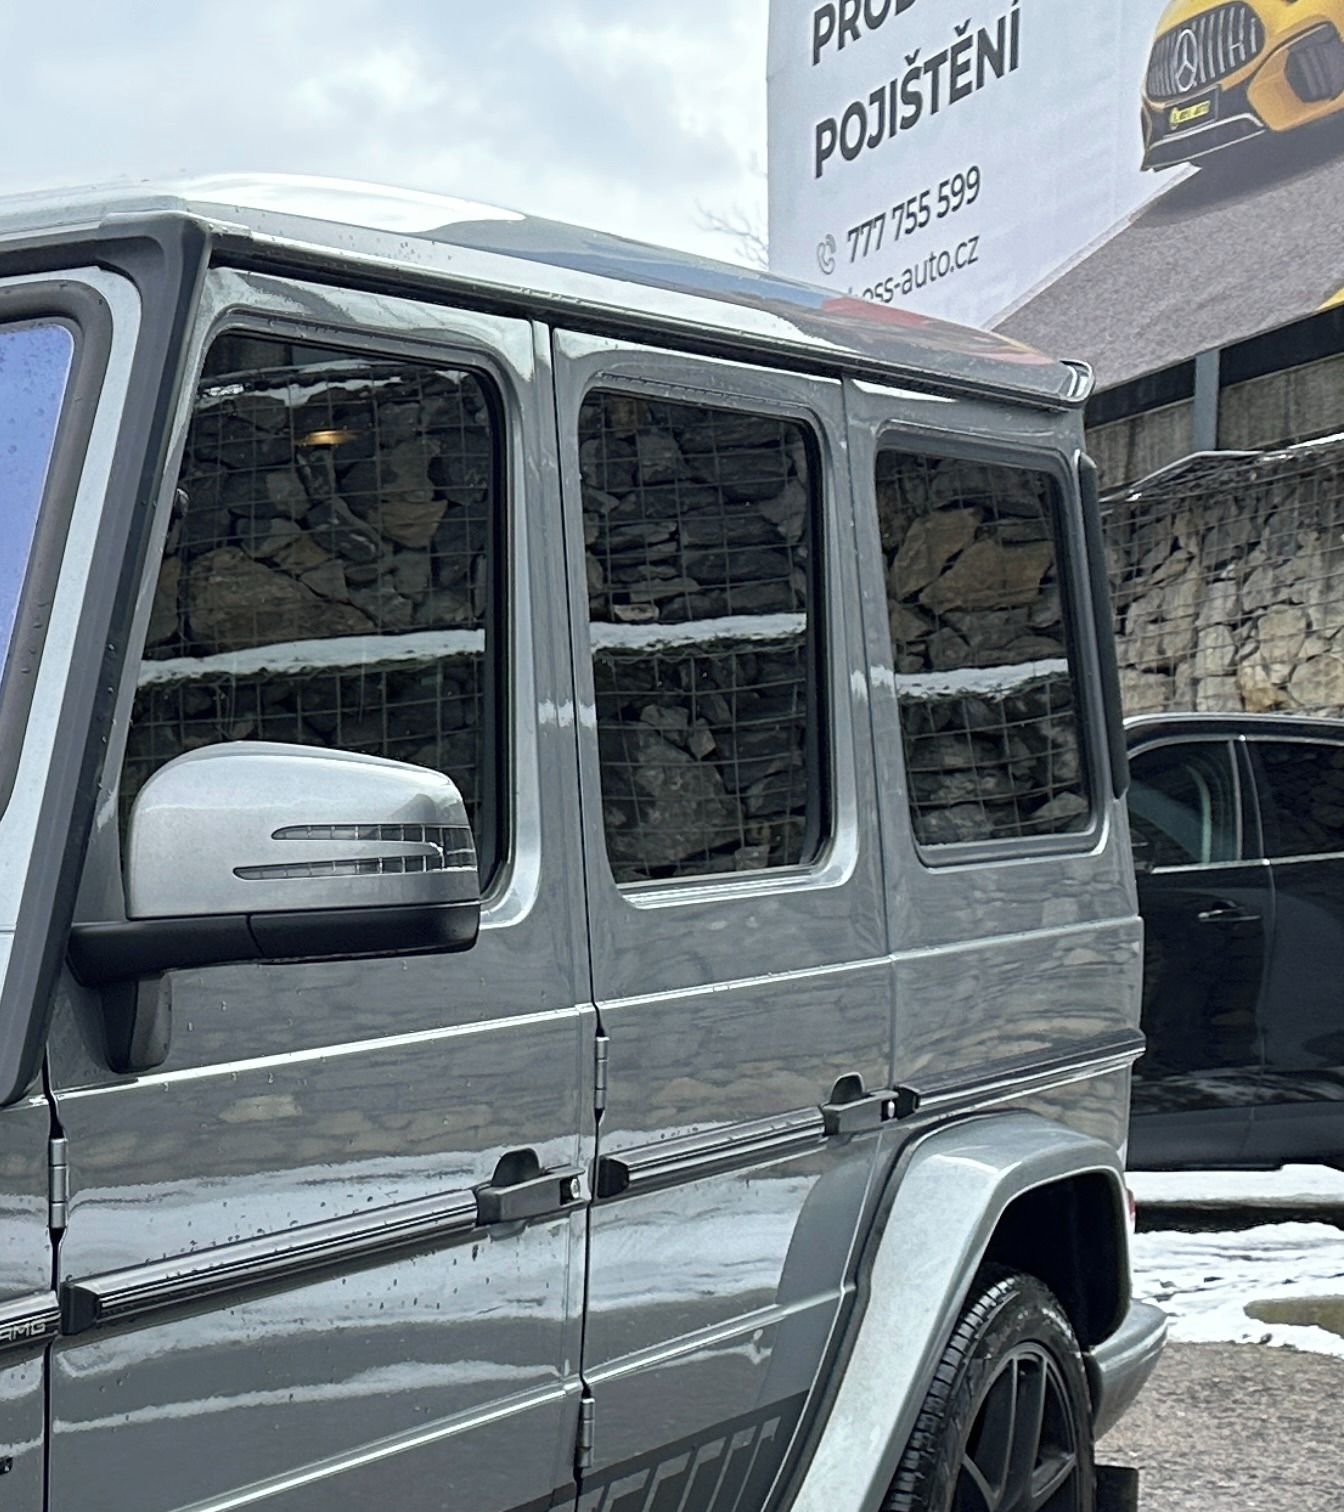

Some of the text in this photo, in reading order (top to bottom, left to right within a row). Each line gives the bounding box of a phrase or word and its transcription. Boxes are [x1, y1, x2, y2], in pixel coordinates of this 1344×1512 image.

[815, 0, 1020, 179] POJIŠTĚNÍ
[847, 165, 980, 263] 777 755 599
